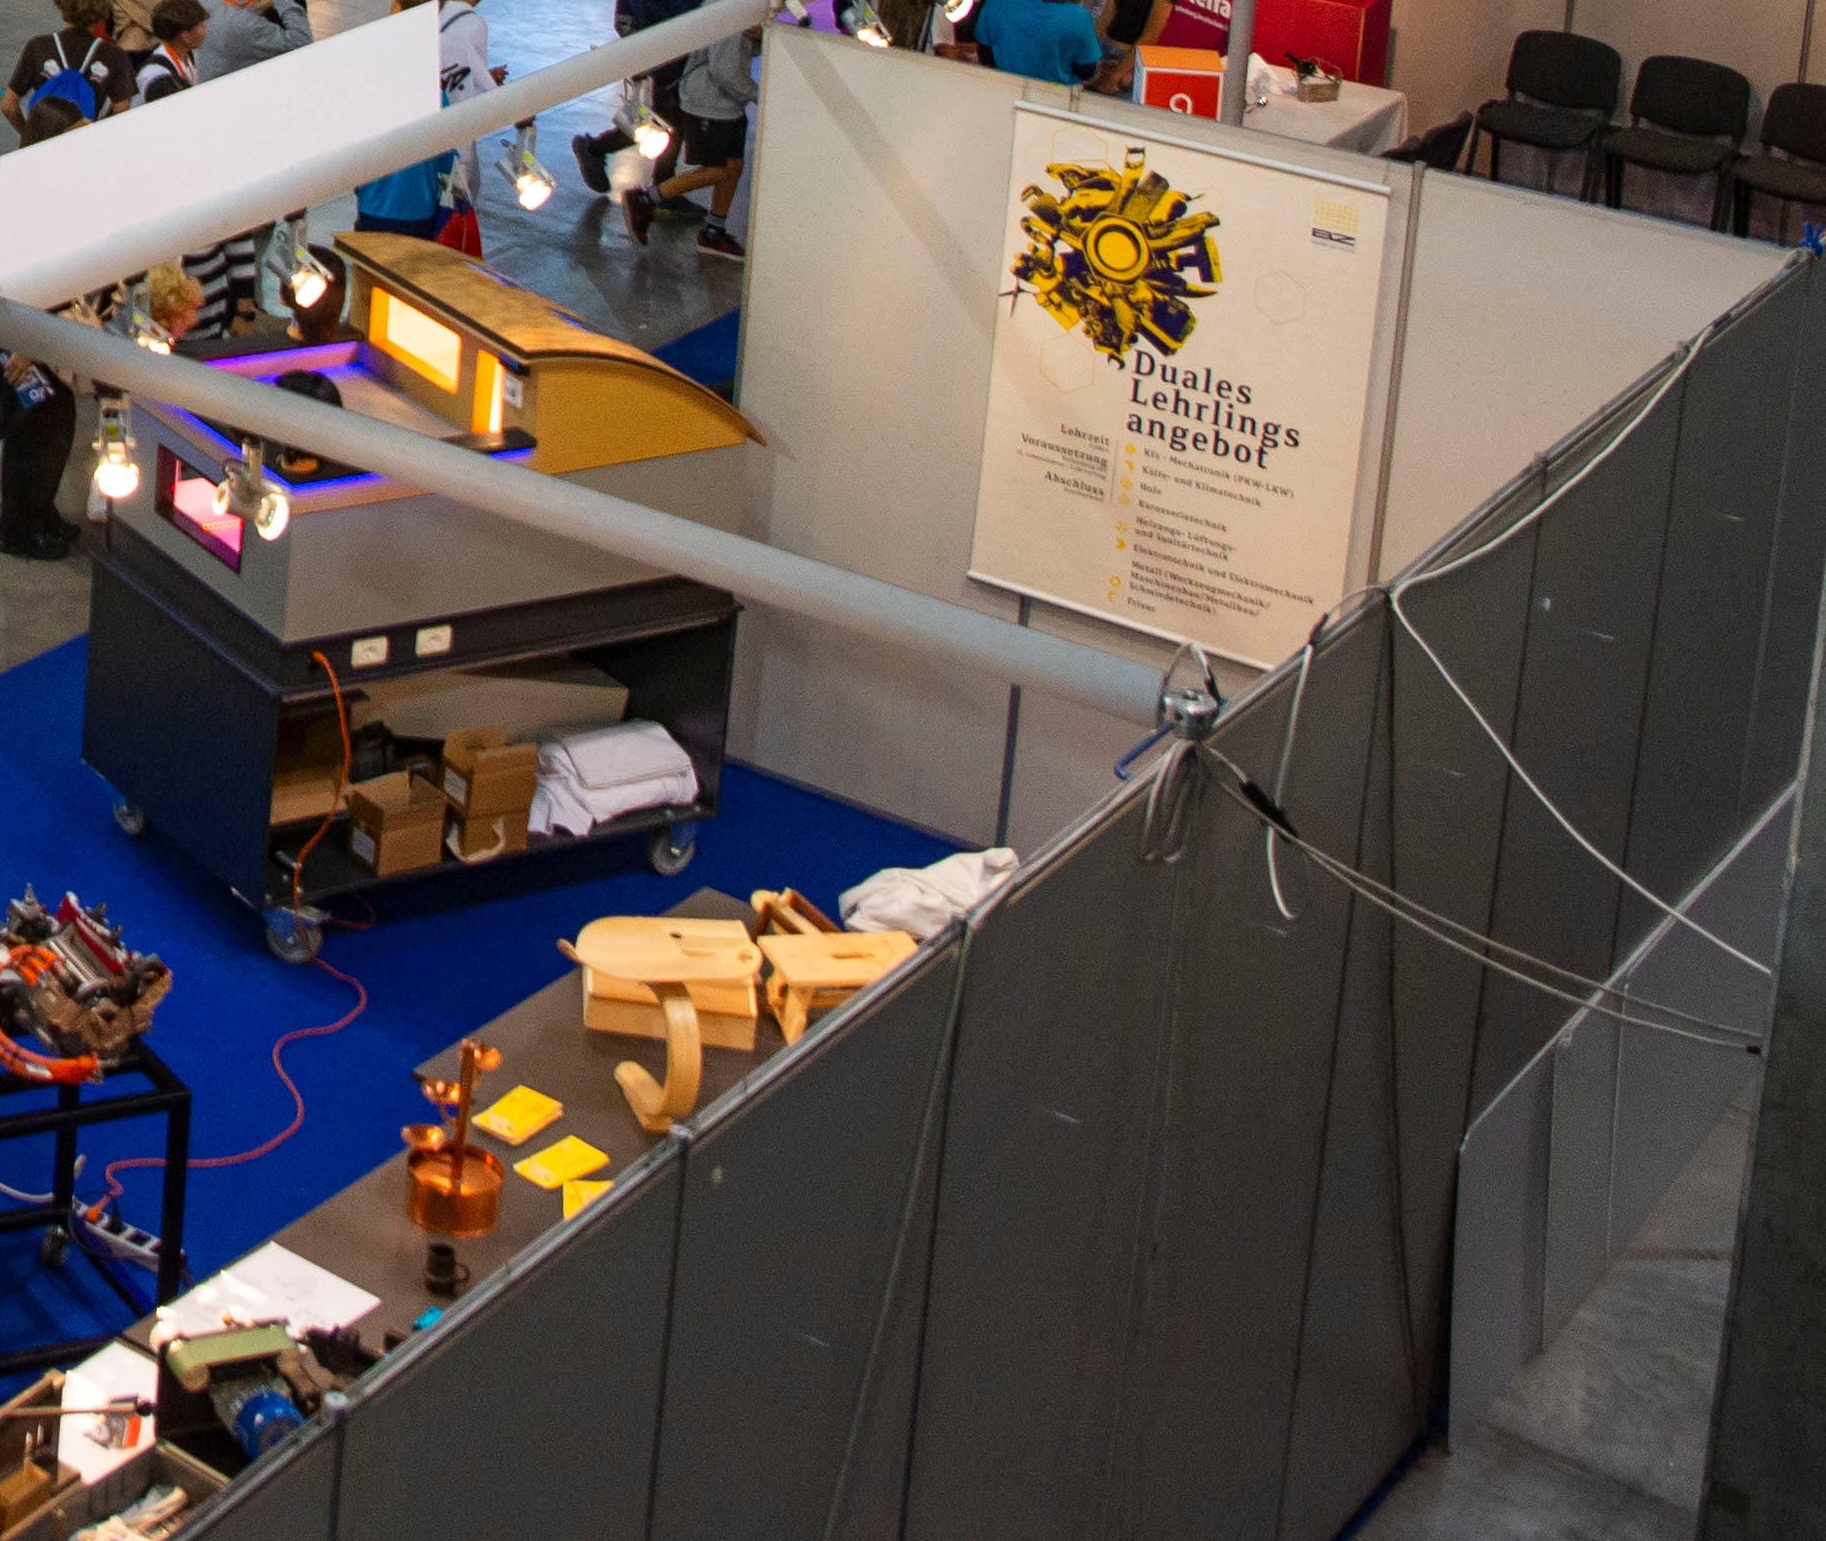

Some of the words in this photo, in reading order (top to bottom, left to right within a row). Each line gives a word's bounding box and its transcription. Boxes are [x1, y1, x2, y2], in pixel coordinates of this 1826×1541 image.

[1132, 348, 1253, 405] Duales
[1128, 377, 1301, 450] Lehrlings
[1020, 432, 1109, 468] Voraussetzung
[1059, 423, 1110, 446] Lehrzeit
[1126, 412, 1270, 469] angebot
[1043, 470, 1105, 497] Abschluss
[1169, 455, 1231, 482] Mechatronik
[1232, 472, 1295, 499] (PKW-LKW)
[1174, 474, 1194, 487] und
[1195, 480, 1262, 508] Klimatechnik
